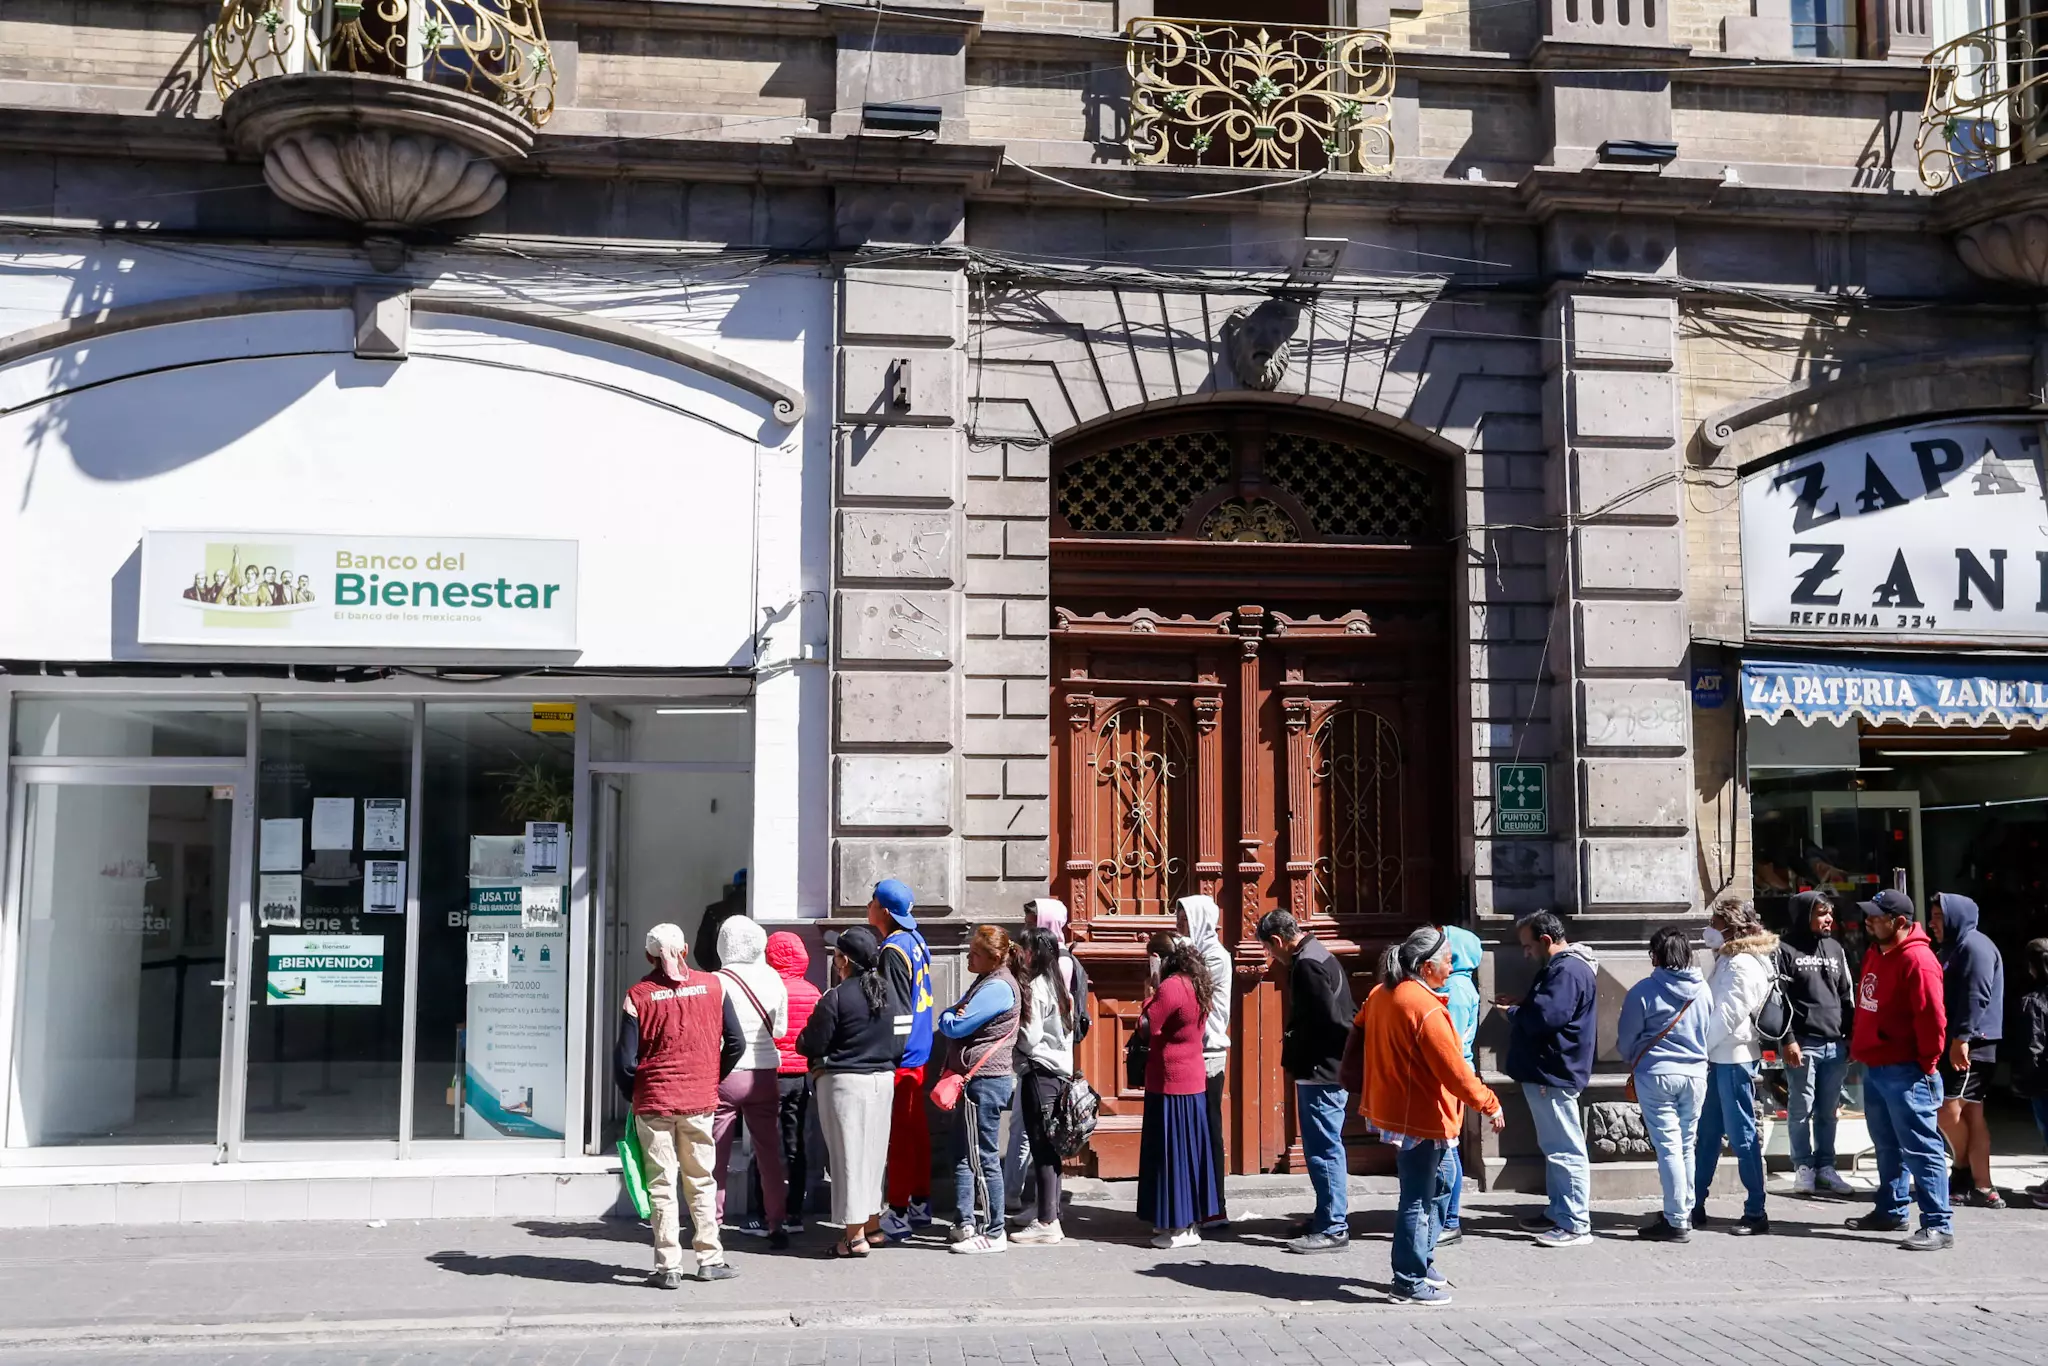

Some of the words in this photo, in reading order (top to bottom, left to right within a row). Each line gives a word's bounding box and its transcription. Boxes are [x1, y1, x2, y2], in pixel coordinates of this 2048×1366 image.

[336, 550, 418, 570] Banco
[426, 552, 464, 570] del
[334, 572, 560, 608] Bienestar
[334, 611, 344, 620] El
[348, 611, 382, 621] banco
[386, 612, 400, 621] de
[404, 612, 418, 621] los
[422, 612, 482, 622] mexicanos
[1790, 611, 1880, 628] REFORMA
[1897, 614, 1937, 629] 334
[1696, 676, 1722, 690] ADT
[1750, 669, 1917, 707] ZAPATERIA
[1504, 820, 1540, 830] REUNIÓN
[480, 891, 502, 903] ¡USA
[503, 892, 516, 902] TU
[278, 956, 373, 971] ¡BIENVENIDO!
[511, 981, 540, 990] 720,000
[651, 988, 674, 1001] MEDIO
